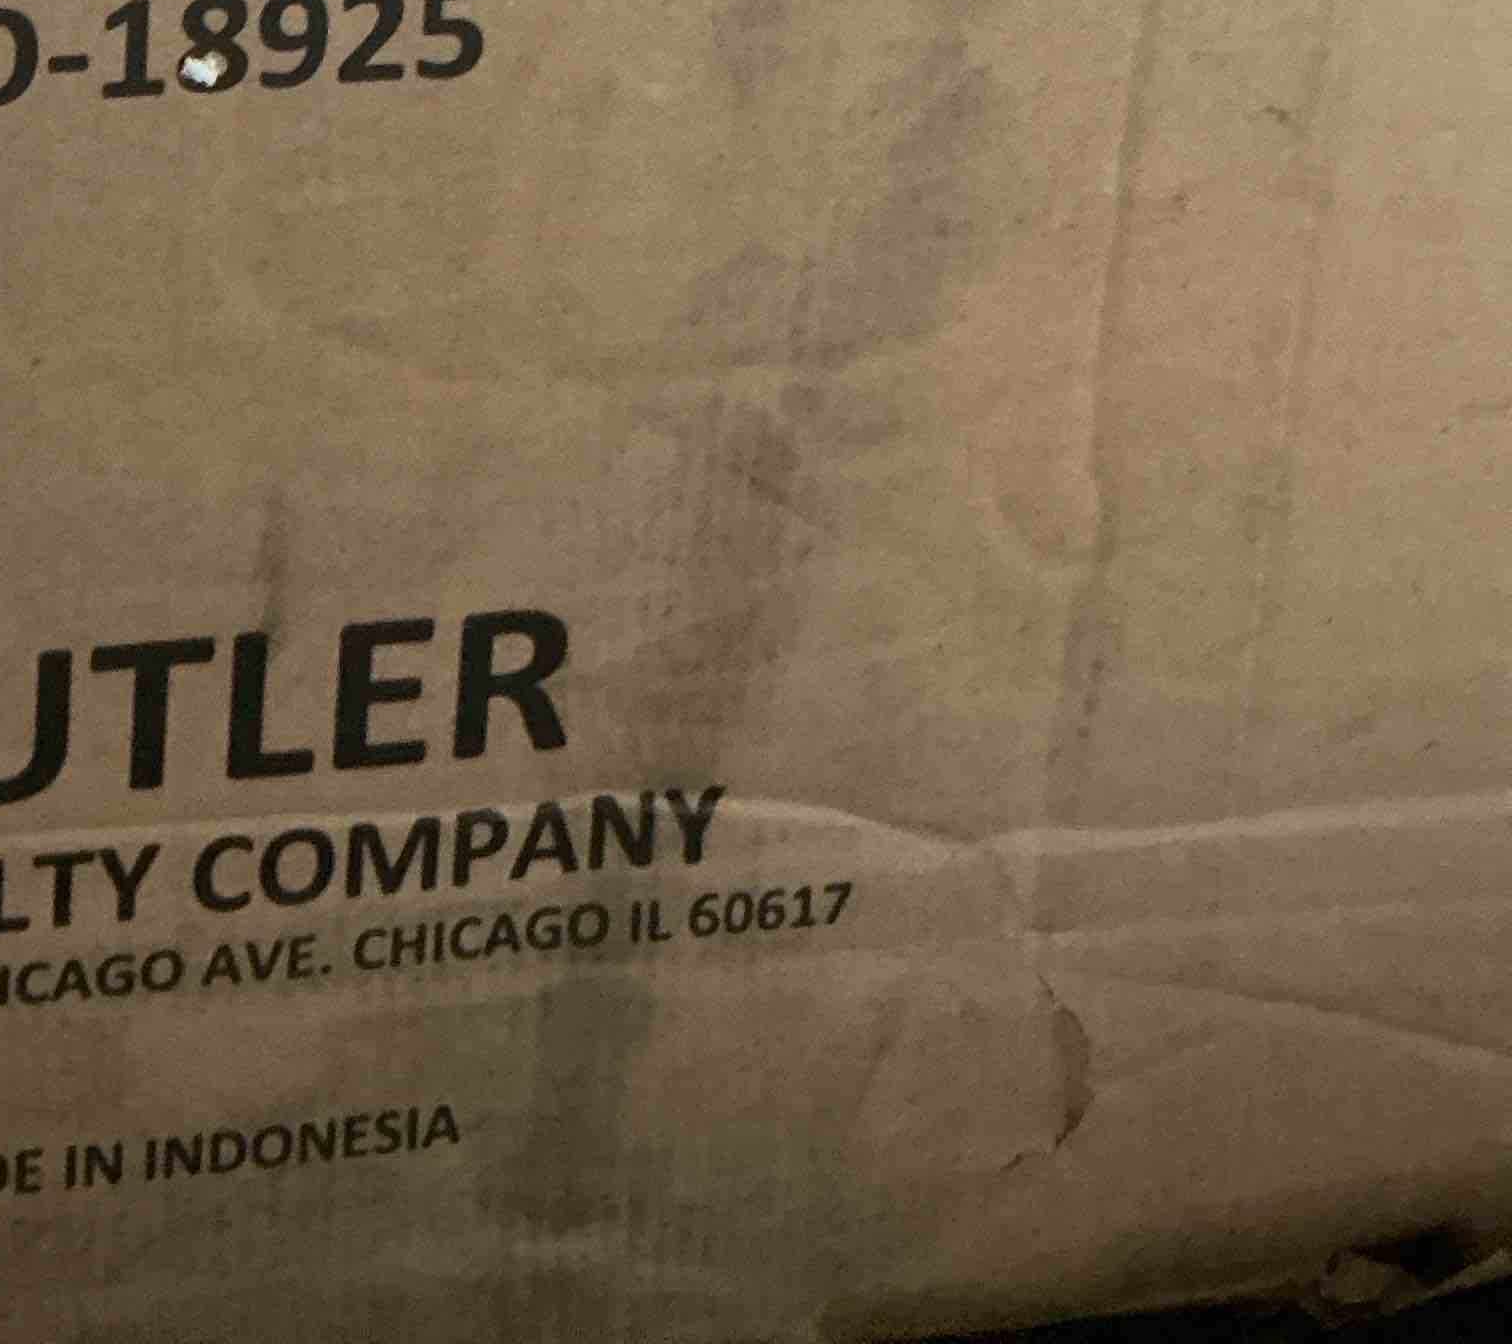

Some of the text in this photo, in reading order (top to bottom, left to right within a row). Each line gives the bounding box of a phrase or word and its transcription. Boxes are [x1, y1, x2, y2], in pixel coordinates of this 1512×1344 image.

[192, 786, 727, 912] COMPANY
[202, 935, 332, 986] AVE.
[353, 902, 610, 972] CHICAGO
[629, 900, 672, 944] IL
[688, 882, 853, 939] 60617
[64, 1141, 123, 1192] IN
[144, 1105, 461, 1182] INDONESIA
